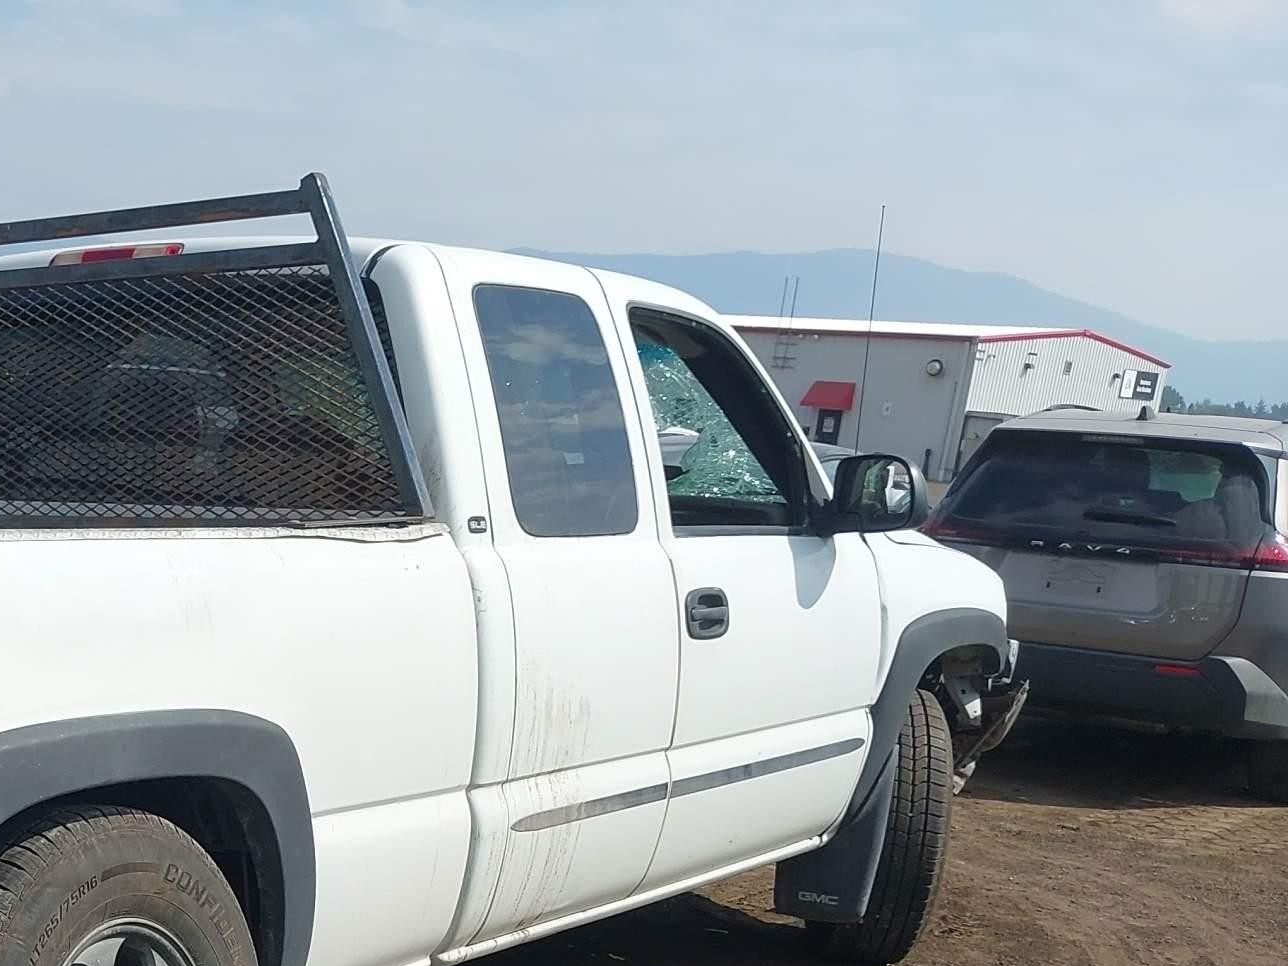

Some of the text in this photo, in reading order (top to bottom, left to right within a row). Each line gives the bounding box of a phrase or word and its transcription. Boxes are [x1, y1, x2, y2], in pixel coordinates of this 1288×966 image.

[469, 520, 487, 529] SLE
[1030, 540, 1131, 555] RAV4
[797, 891, 841, 906] GMC
